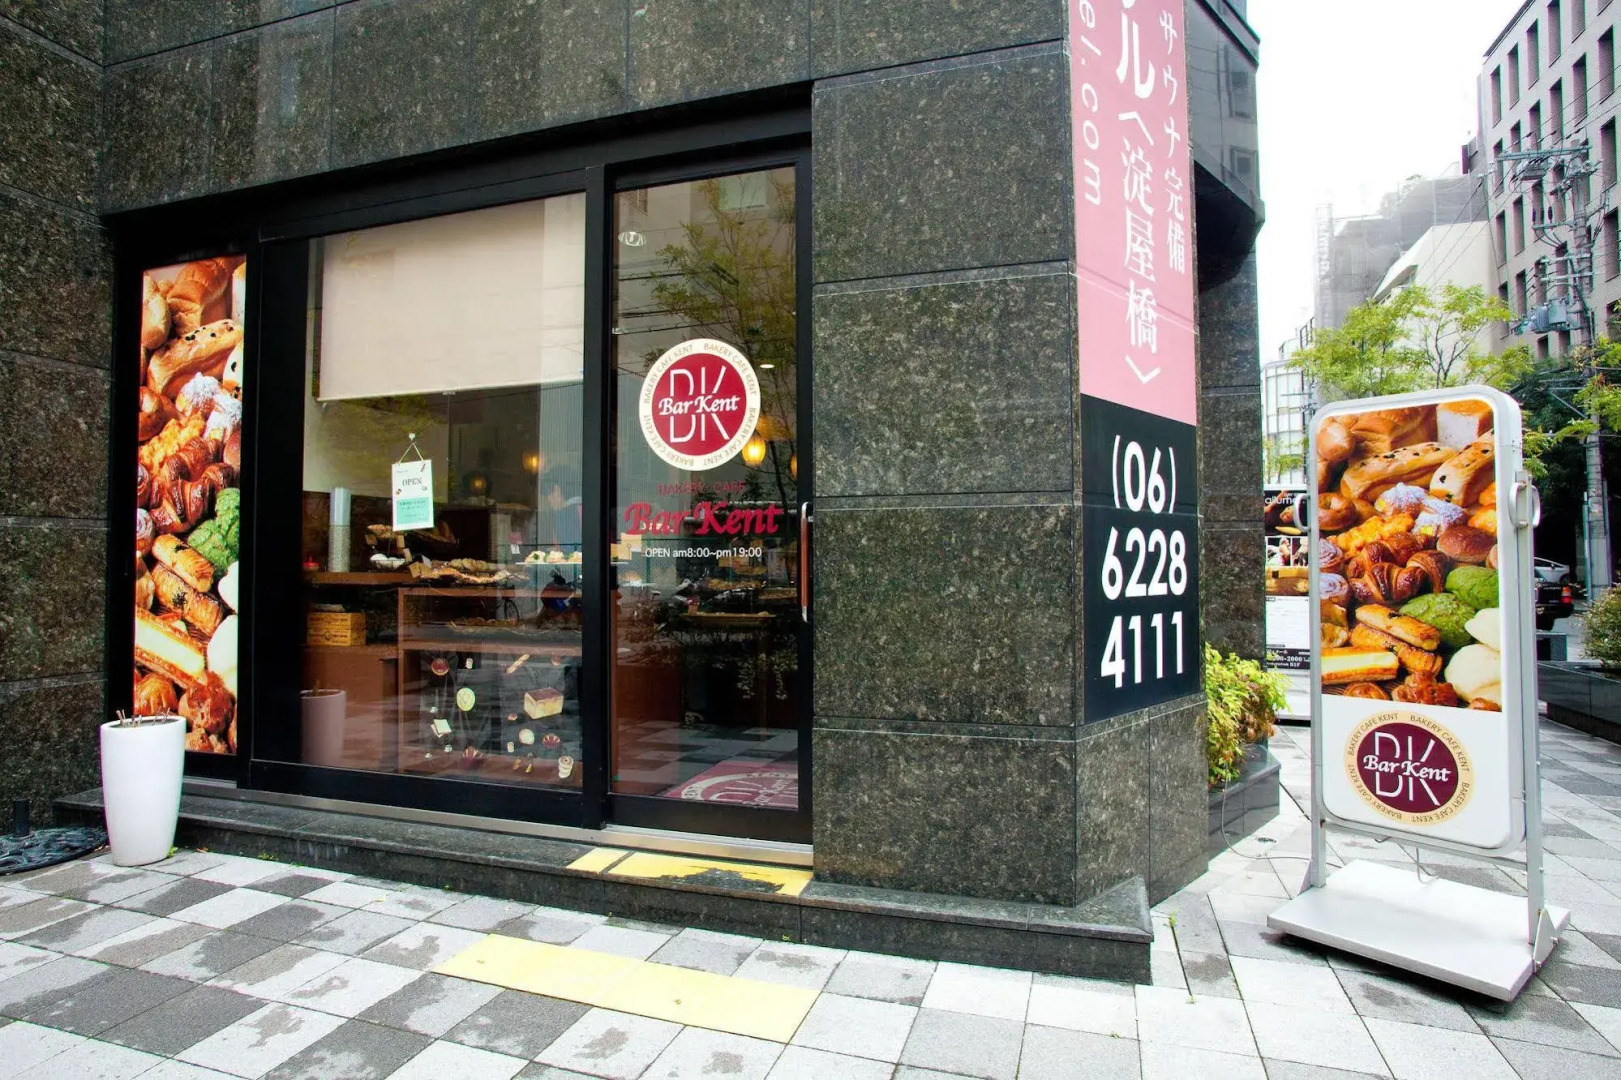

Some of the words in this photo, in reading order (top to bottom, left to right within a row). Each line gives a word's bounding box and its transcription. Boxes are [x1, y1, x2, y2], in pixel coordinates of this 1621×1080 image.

[1159, 9, 1186, 275] サウナ完備
[1116, 0, 1162, 384] ル〈淀屋橋〉
[674, 344, 693, 360] KENT
[704, 343, 731, 357] BAKERY
[732, 354, 746, 374] CAFE
[747, 373, 757, 395] KENT
[658, 397, 694, 416] Bar
[694, 394, 740, 413] Kent
[402, 478, 423, 486] OPEN
[656, 482, 706, 497] BAKERY
[713, 480, 746, 494] CAFE
[1112, 434, 1177, 515] (06)
[624, 501, 690, 536] Bar
[692, 498, 785, 536] Kent
[645, 547, 671, 558] OPEN
[1101, 526, 1188, 601] 6228
[1100, 610, 1184, 689] 4111
[1347, 730, 1361, 756] BAKERY
[1360, 717, 1377, 731] CAFE
[1378, 713, 1399, 722] KENT
[1410, 714, 1442, 733] BAKERY
[1442, 732, 1460, 750] CAFE
[1457, 748, 1470, 772] KENT
[1348, 764, 1360, 785] KENT
[1363, 754, 1401, 774] Bar
[1401, 760, 1452, 782] Kent
[1356, 784, 1372, 801] CAFE
[1453, 782, 1470, 810] BAKERY
[1372, 800, 1403, 820] BAKERY
[1411, 813, 1434, 823] KENT
[1435, 806, 1454, 821] CAFE
